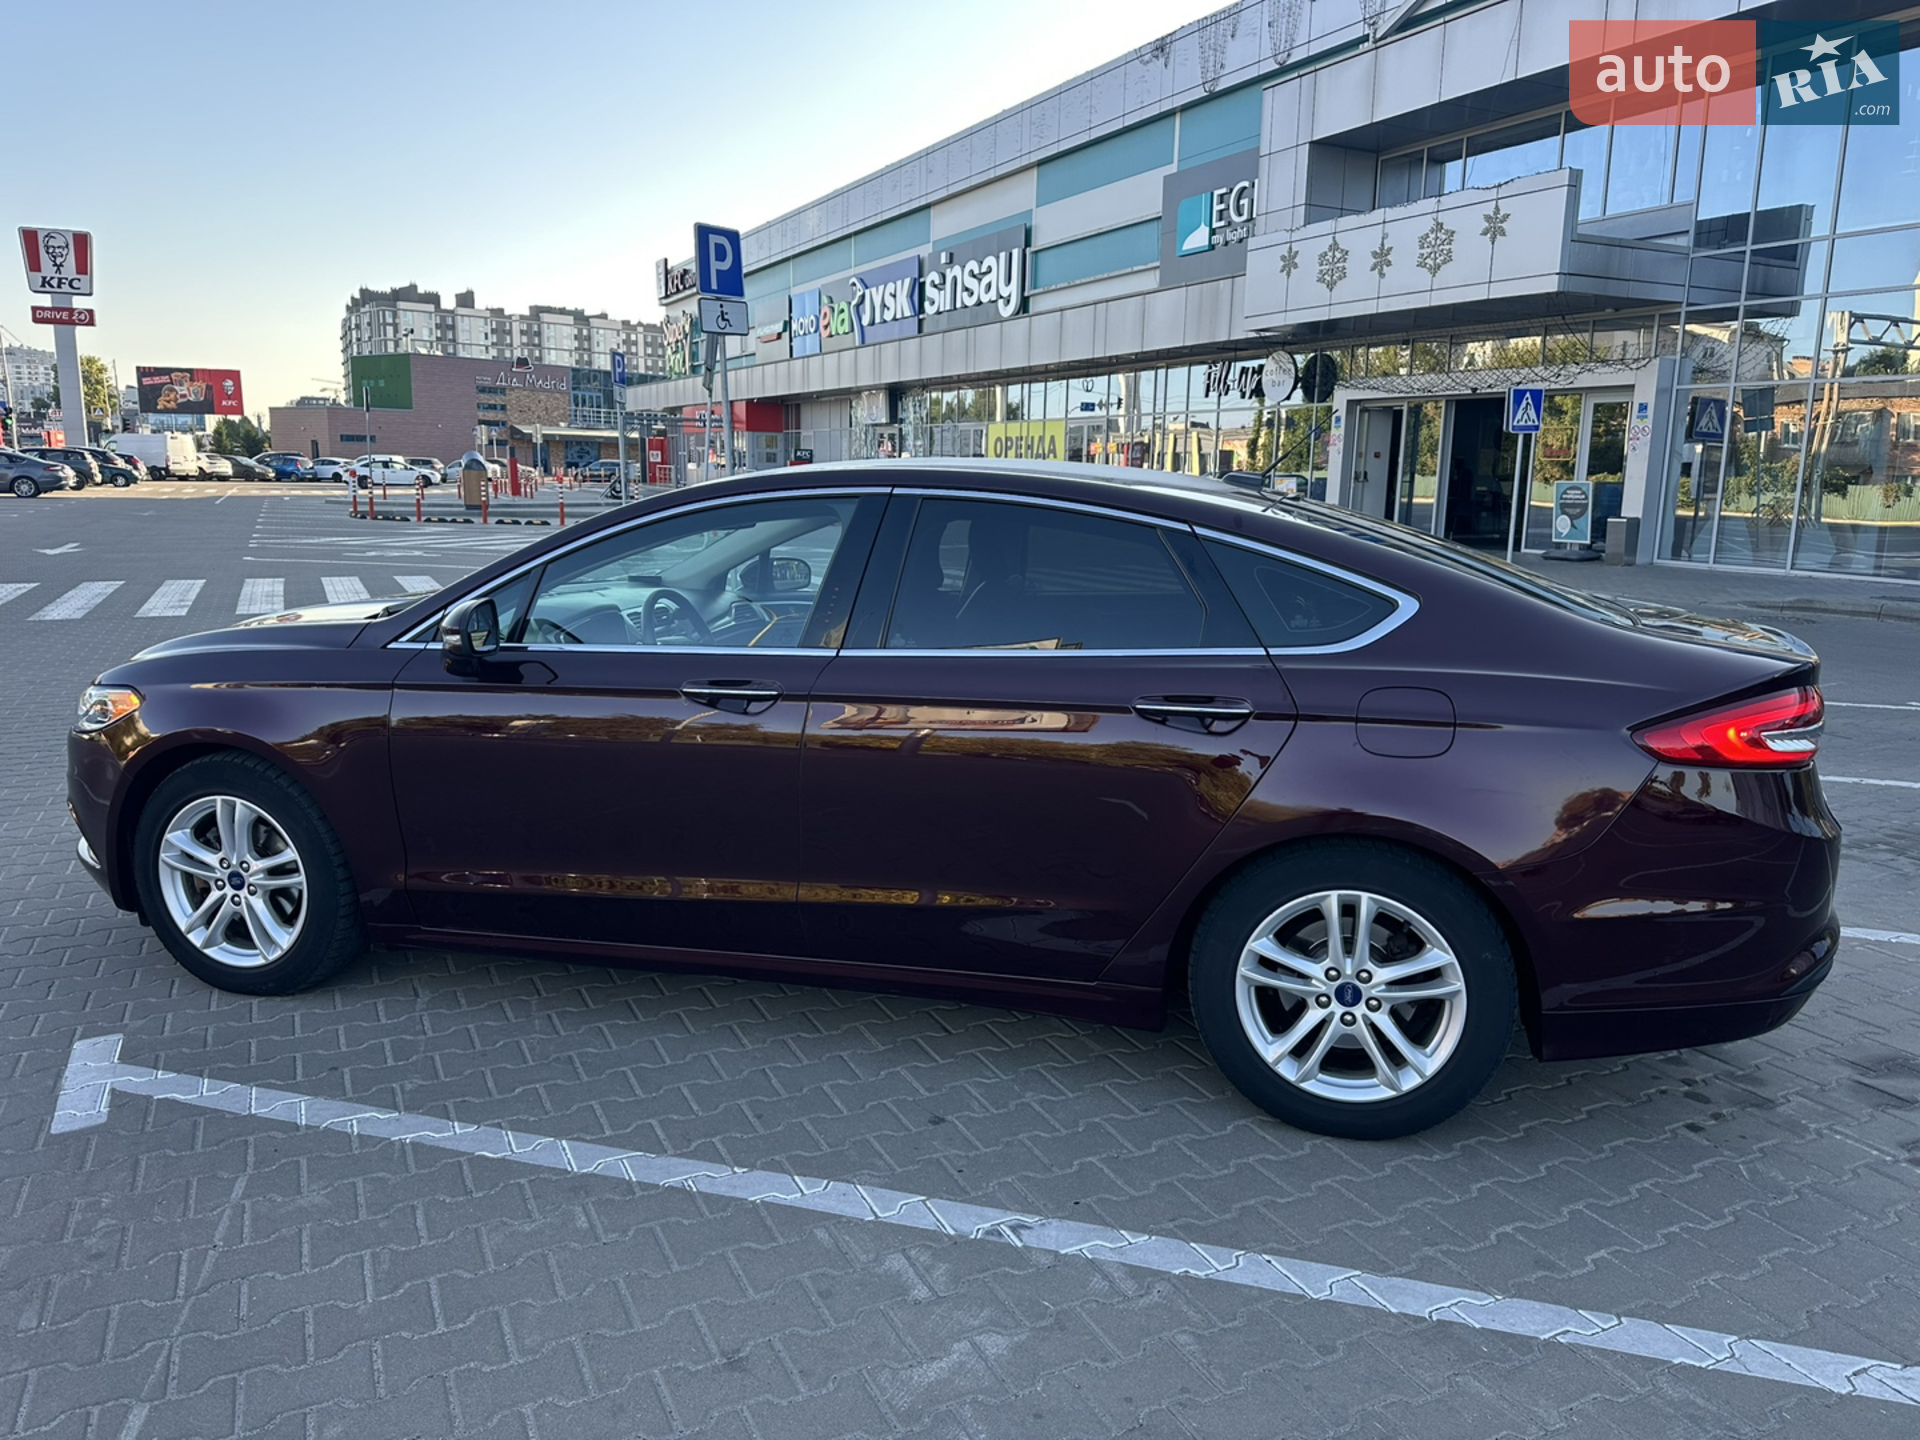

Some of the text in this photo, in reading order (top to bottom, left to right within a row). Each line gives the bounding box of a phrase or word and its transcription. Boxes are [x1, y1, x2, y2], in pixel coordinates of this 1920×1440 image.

[1211, 226, 1249, 247] my light
[708, 233, 734, 291] P
[39, 275, 82, 290] KFC
[924, 247, 1023, 318] sinsay
[861, 277, 915, 327] JYSK
[36, 310, 69, 320] DRIVE
[615, 354, 624, 382] P
[525, 373, 567, 390] Madrid
[1271, 379, 1286, 387] bar
[994, 435, 1057, 459] ОРЕНДА
